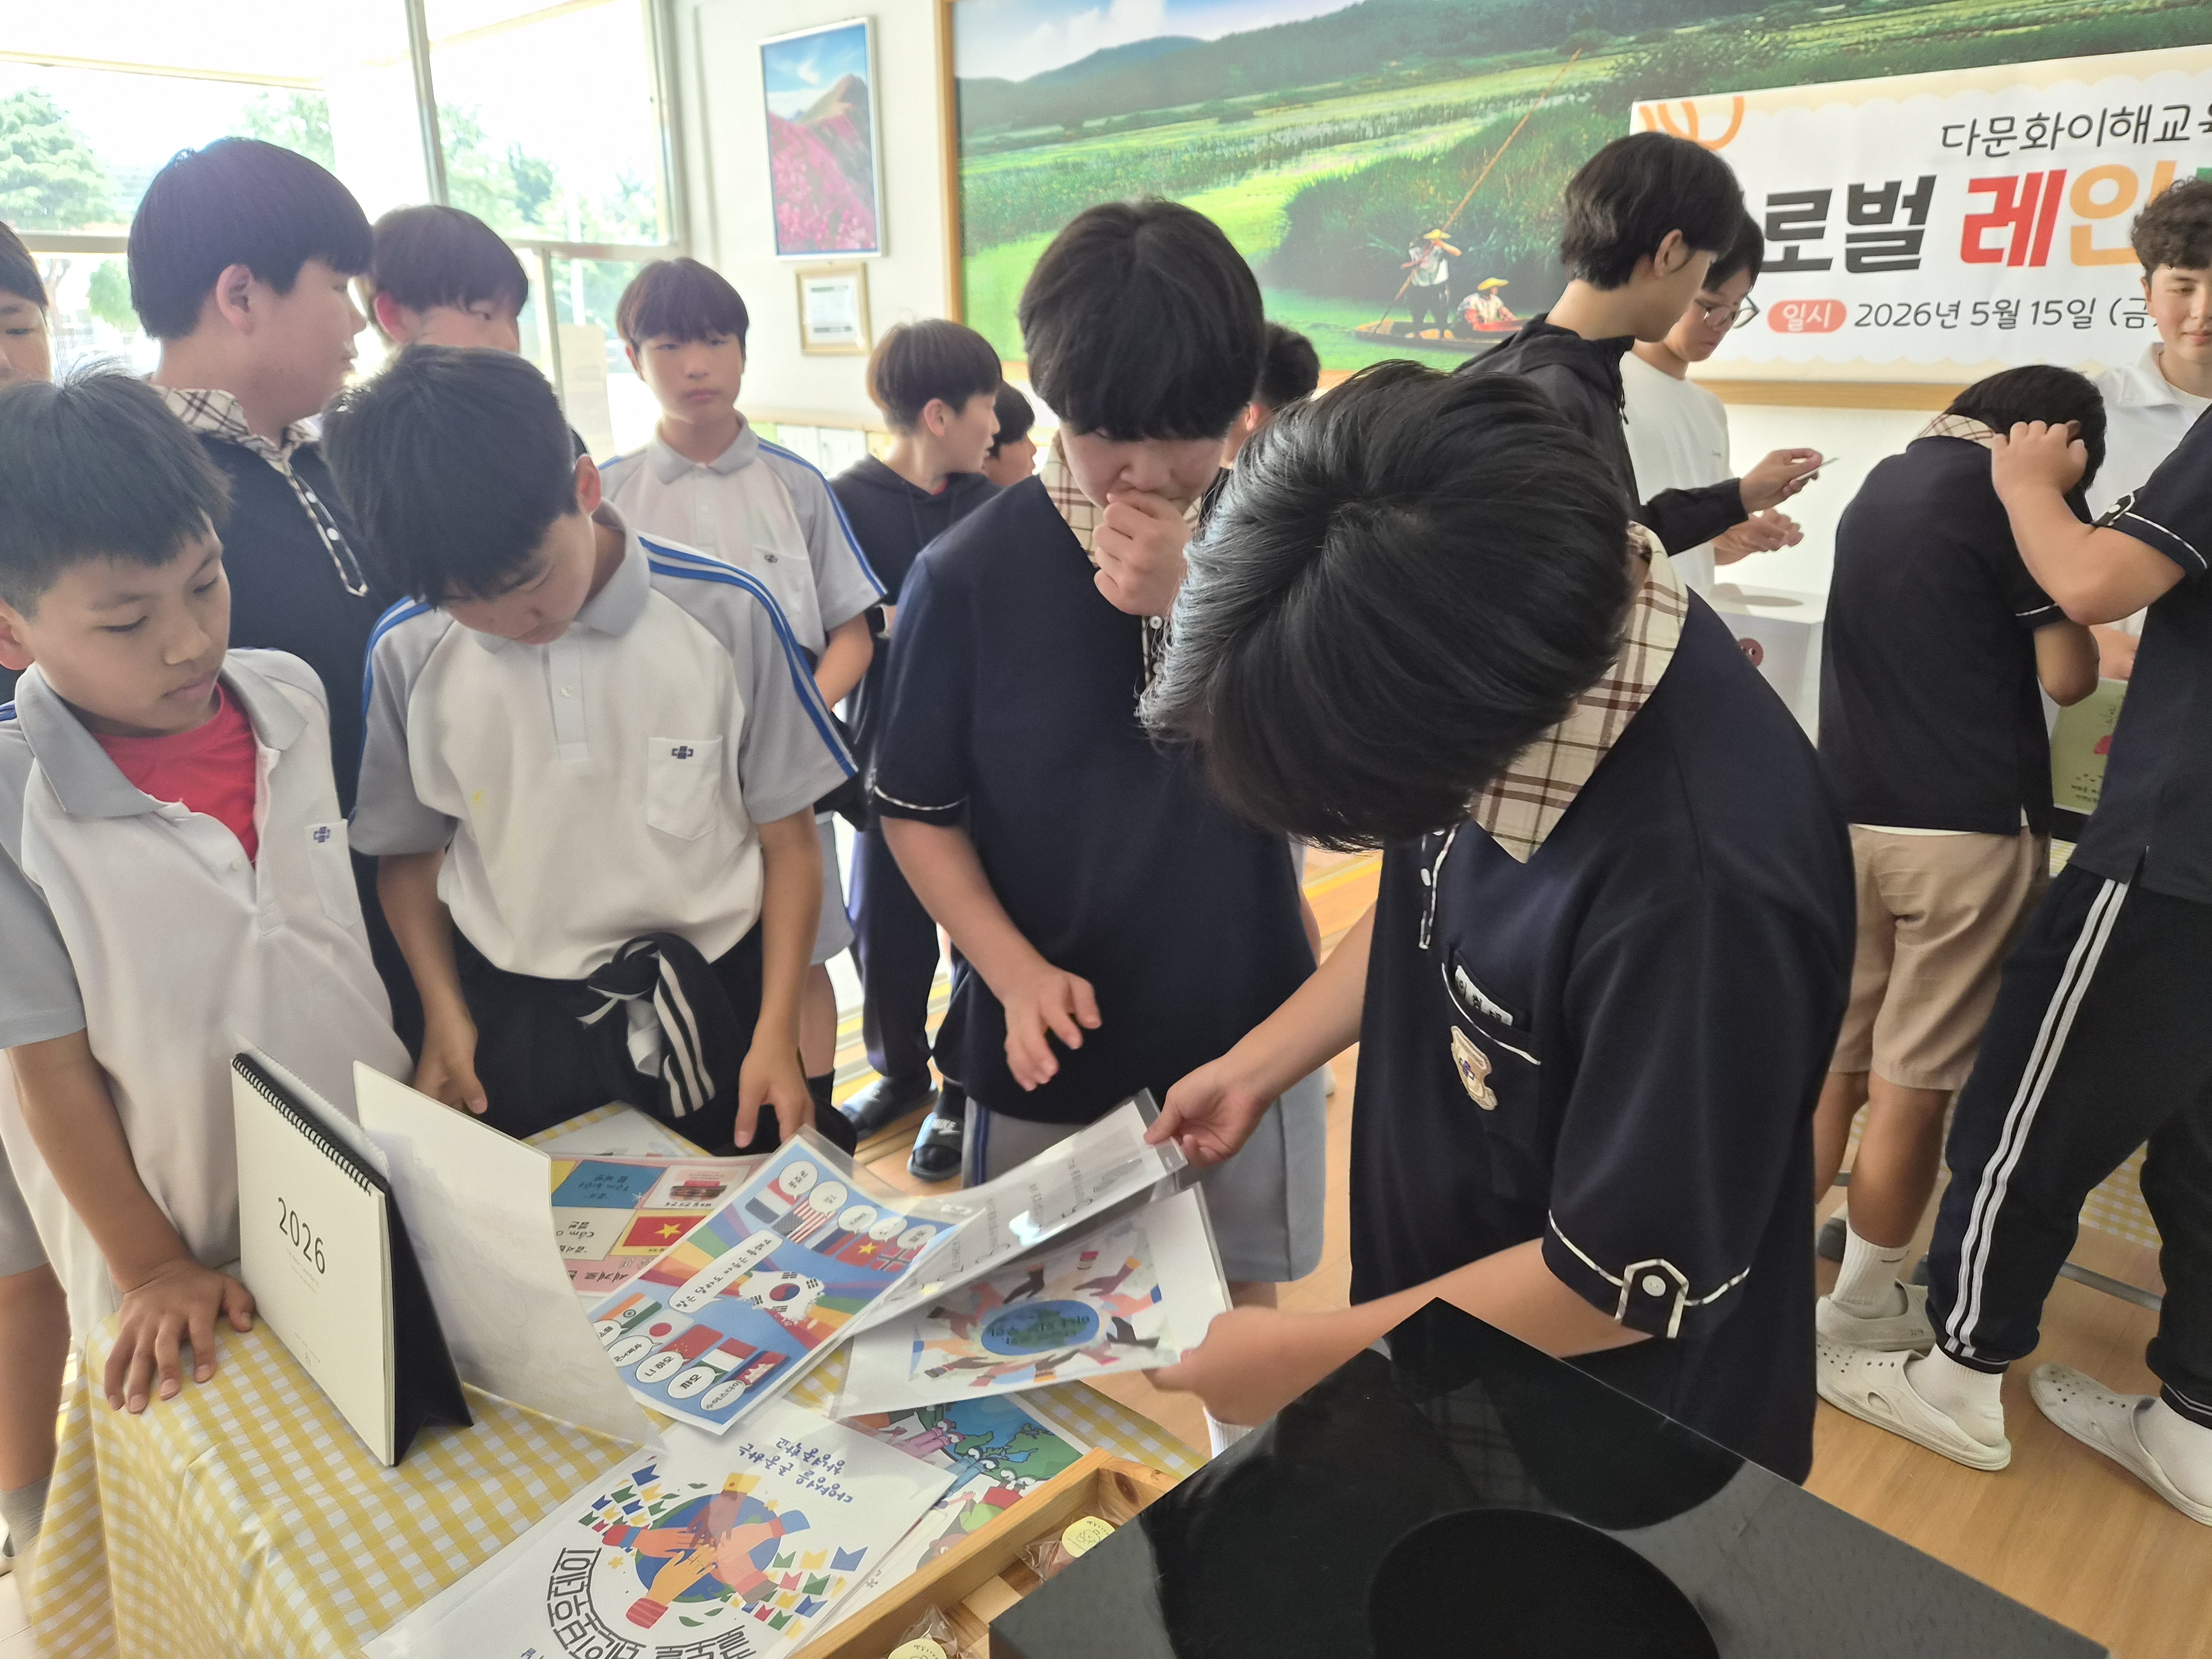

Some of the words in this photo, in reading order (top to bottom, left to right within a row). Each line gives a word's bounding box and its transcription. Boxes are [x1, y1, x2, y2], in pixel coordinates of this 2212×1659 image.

[1760, 174, 1937, 273] 로벌
[1960, 160, 2212, 267] 레인
[1782, 302, 1832, 332] 일시
[1854, 300, 1961, 330] 2026년
[1970, 299, 2020, 330] 5월
[2031, 298, 2096, 329] 15일
[2109, 298, 2158, 329] (금
[278, 1196, 326, 1275] 2026
[585, 1271, 628, 1282] 세계로
[676, 1294, 697, 1308] 말은
[695, 1275, 723, 1295] 달라도
[723, 1256, 749, 1275] 마음은
[654, 1355, 675, 1370] 하오
[738, 1443, 794, 1477] 존중하는
[775, 1437, 845, 1475] 창녕중학교
[795, 1470, 853, 1503] 다양성을
